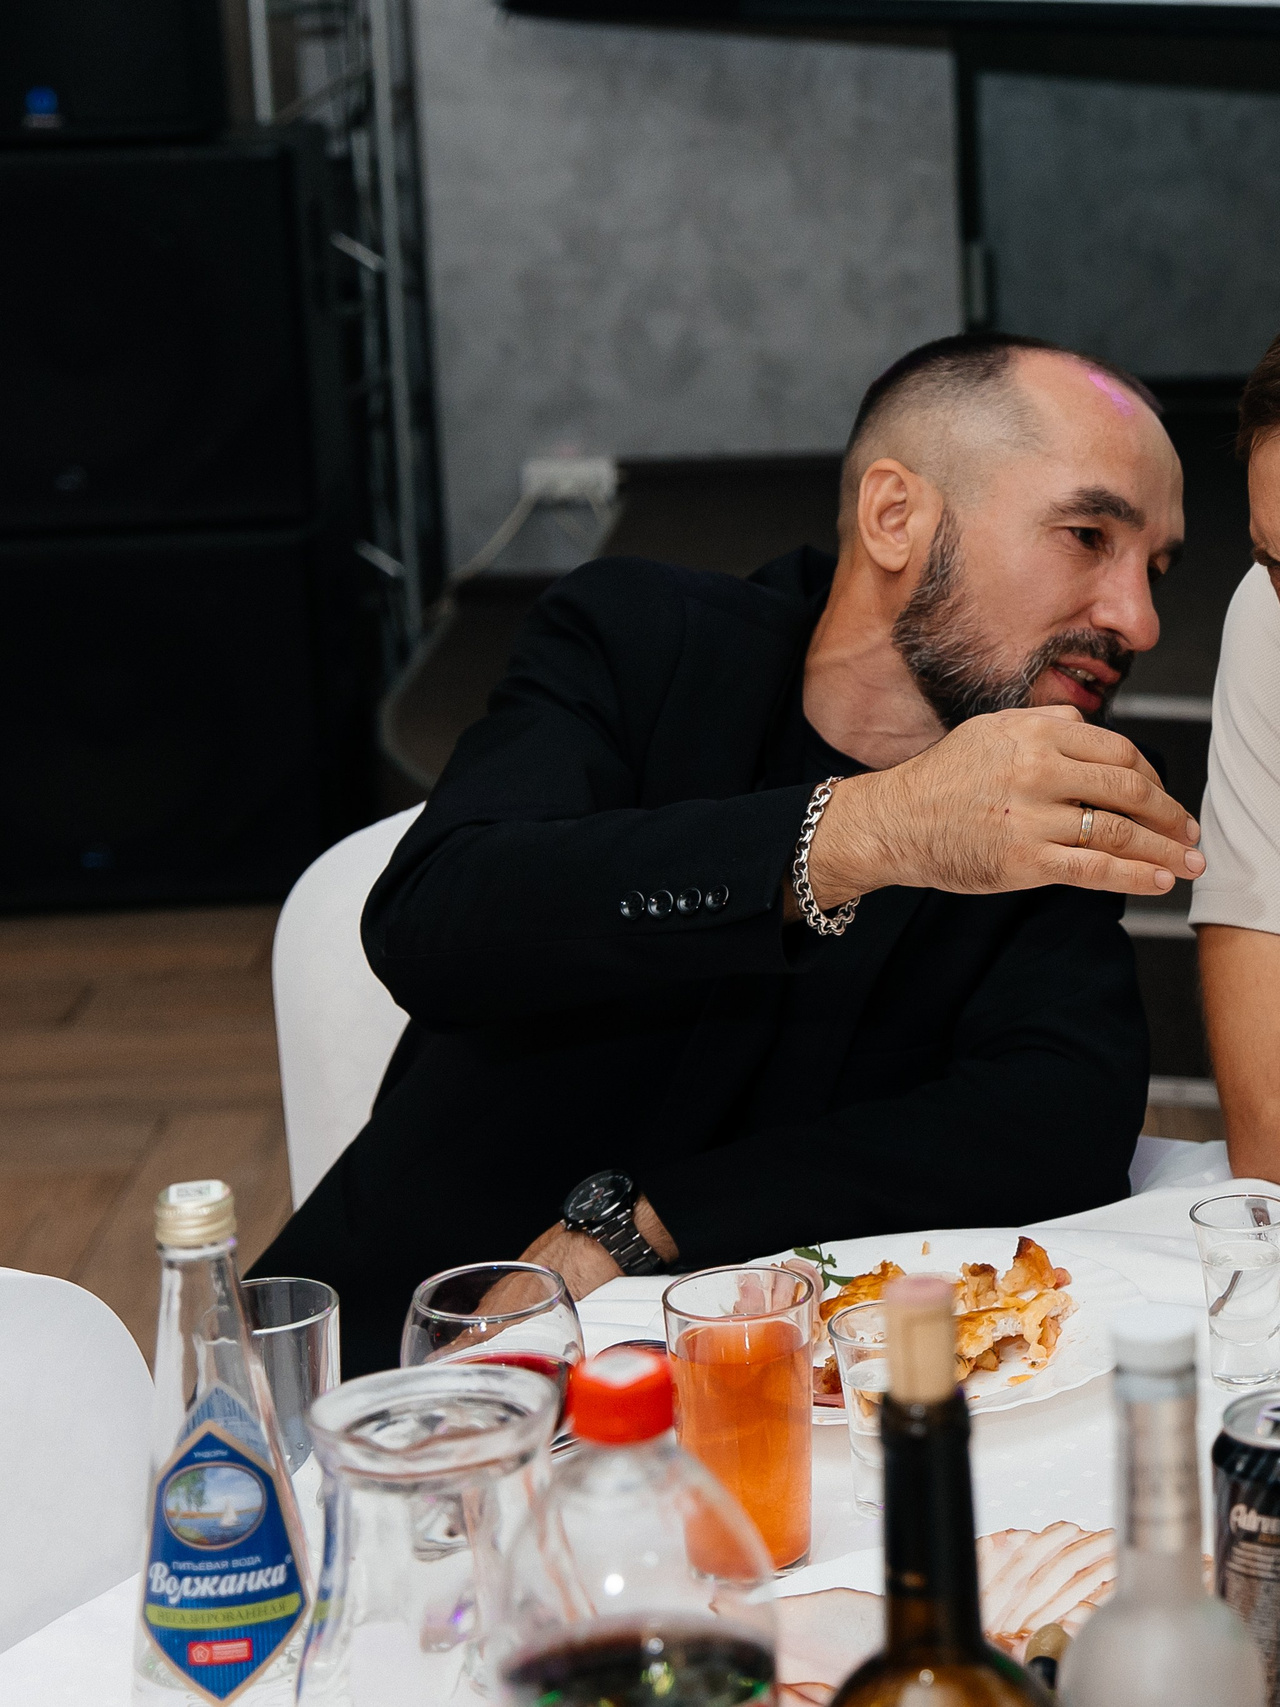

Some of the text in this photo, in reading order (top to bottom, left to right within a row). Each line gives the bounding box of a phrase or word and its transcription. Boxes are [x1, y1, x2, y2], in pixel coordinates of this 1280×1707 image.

[172, 1556, 262, 1571] ПИТЬЕВАЯ ВОДА
[149, 1562, 287, 1604] Волжанка
